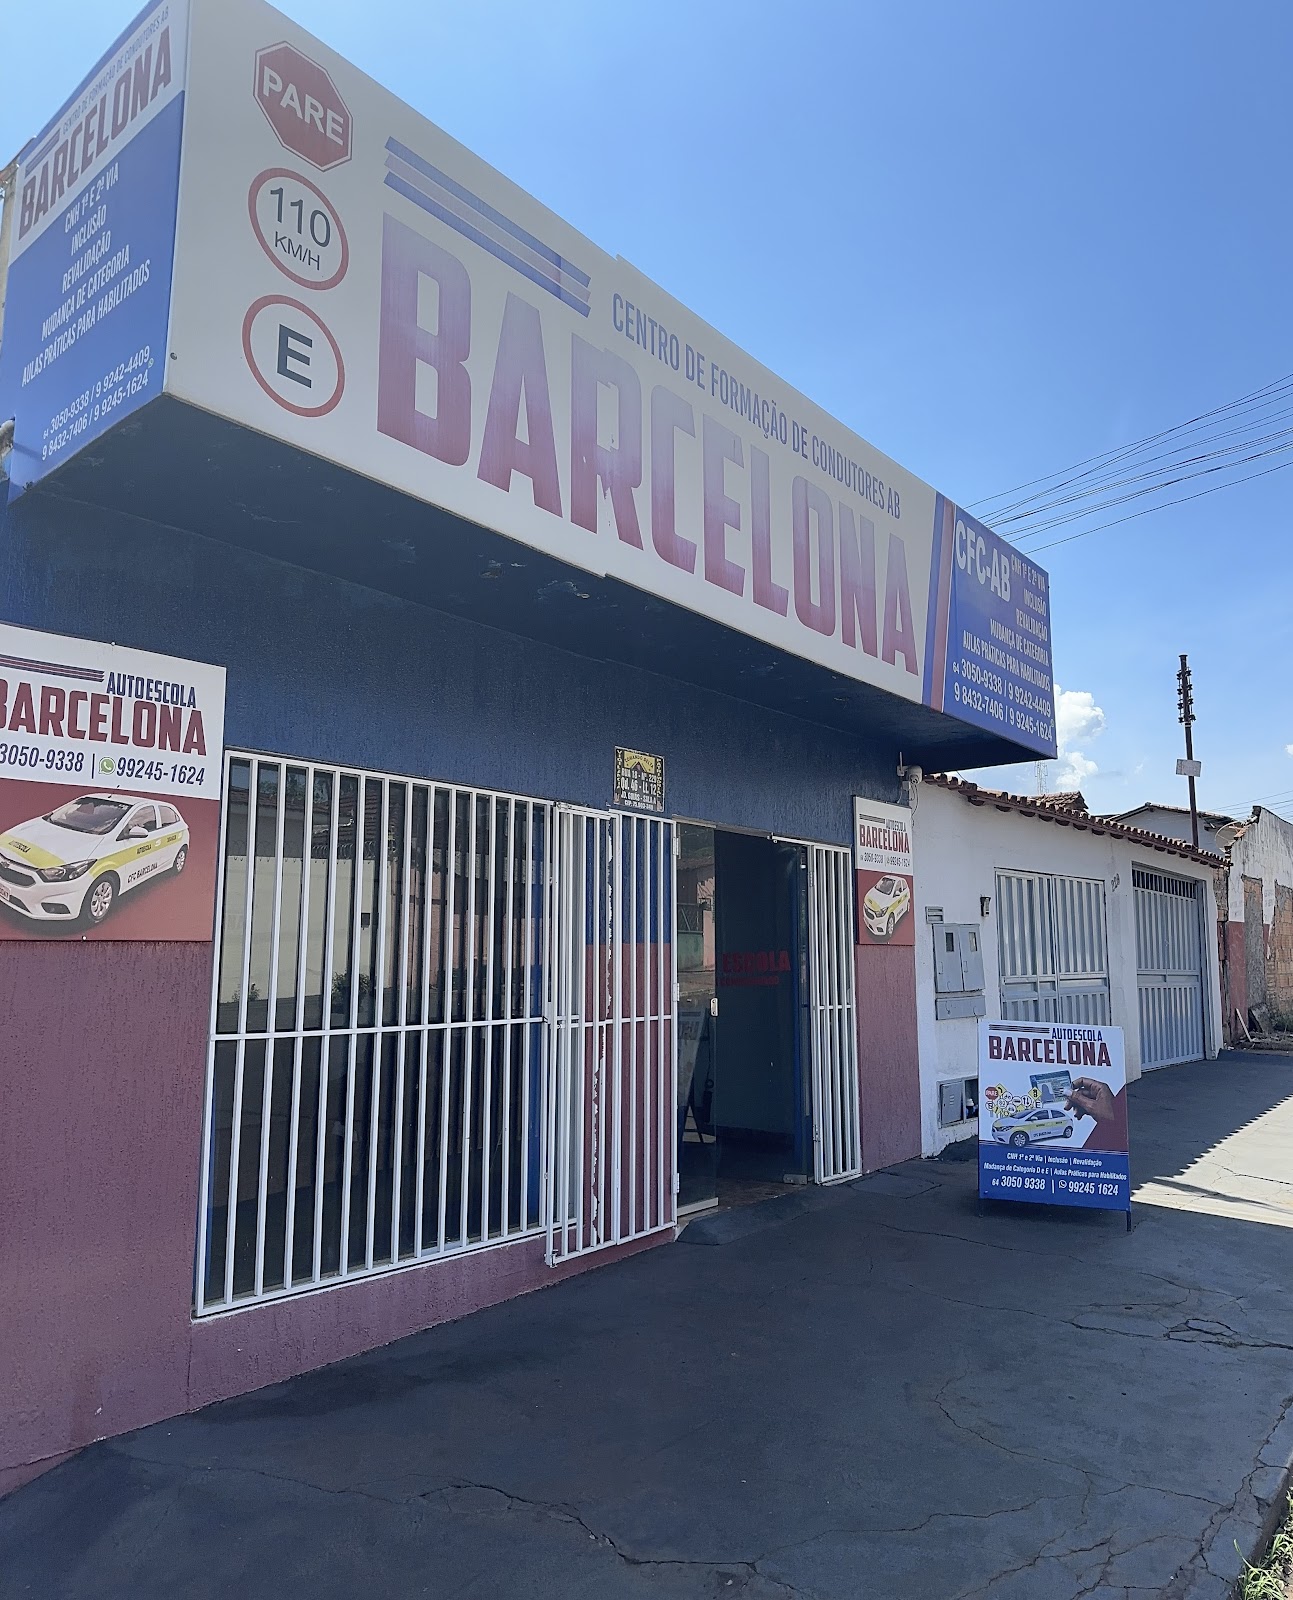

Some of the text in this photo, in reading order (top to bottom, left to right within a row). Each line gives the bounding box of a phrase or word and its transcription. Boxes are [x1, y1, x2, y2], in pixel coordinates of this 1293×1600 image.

[18, 25, 172, 241] BARCELONA
[262, 65, 344, 146] PARE
[64, 204, 80, 233] CNH
[90, 189, 96, 208] E
[106, 162, 119, 190] VIA
[269, 187, 331, 249] 110
[70, 204, 107, 256] INCLUSÃO
[274, 230, 321, 272] KM/H
[62, 230, 112, 294] REVALIDAÇÃO
[22, 259, 150, 388] AULAS PRÁTICAS PARA HABILITADOS
[42, 244, 130, 342] MUDANÇA DE CATEGORIA
[276, 323, 314, 389] E
[42, 444, 48, 462] 9
[48, 413, 88, 457] 8432-7406
[94, 404, 100, 422] 9
[102, 369, 149, 417] 9245-1624
[50, 390, 90, 435] 3050-9338
[96, 380, 102, 398] 9
[103, 345, 150, 392] 9242-4409
[612, 292, 902, 520] CENTRO DE FORMAÇÃO DE CONDUTORES AB
[377, 211, 919, 676] BARCELONA
[956, 519, 1011, 603] CFC-AB
[1011, 554, 1022, 577] CNH
[1038, 574, 1046, 593] VIA
[962, 630, 981, 656] AULAS
[1006, 653, 1020, 678] PARA
[1020, 660, 1051, 692] HABILITADOS
[990, 618, 1050, 668] MUDANÇA DE CATEGORIA
[106, 671, 197, 709] AUTOESCOLA
[952, 661, 960, 675] 64
[961, 658, 1002, 696] 3050-9338
[1008, 682, 1014, 700] 9
[1014, 684, 1051, 718] 9242-4409
[954, 682, 960, 702] 9
[962, 686, 1004, 722] 8432-7406
[1010, 708, 1015, 726] 9
[1016, 709, 1052, 742] 9245-1624
[0, 743, 206, 786] 3050-9338 99245-1624
[860, 824, 910, 854] BARCELONA
[988, 1035, 1112, 1067] BARCELONA
[1051, 1027, 1103, 1042] AUTOESCOLA
[984, 1162, 1006, 1172] Mudança
[1006, 1164, 1012, 1172] de
[1013, 1164, 1036, 1174] Categoria
[1054, 1168, 1068, 1176] Aulas
[1088, 1171, 1100, 1179] para
[1100, 1171, 1128, 1180] Habilitados
[992, 1176, 1119, 1196] 64 3050 9338 99245 1624
[1007, 1152, 1018, 1160] CNH
[1048, 1156, 1068, 1164] Inclusão
[1073, 1158, 1102, 1168] Revalidação
